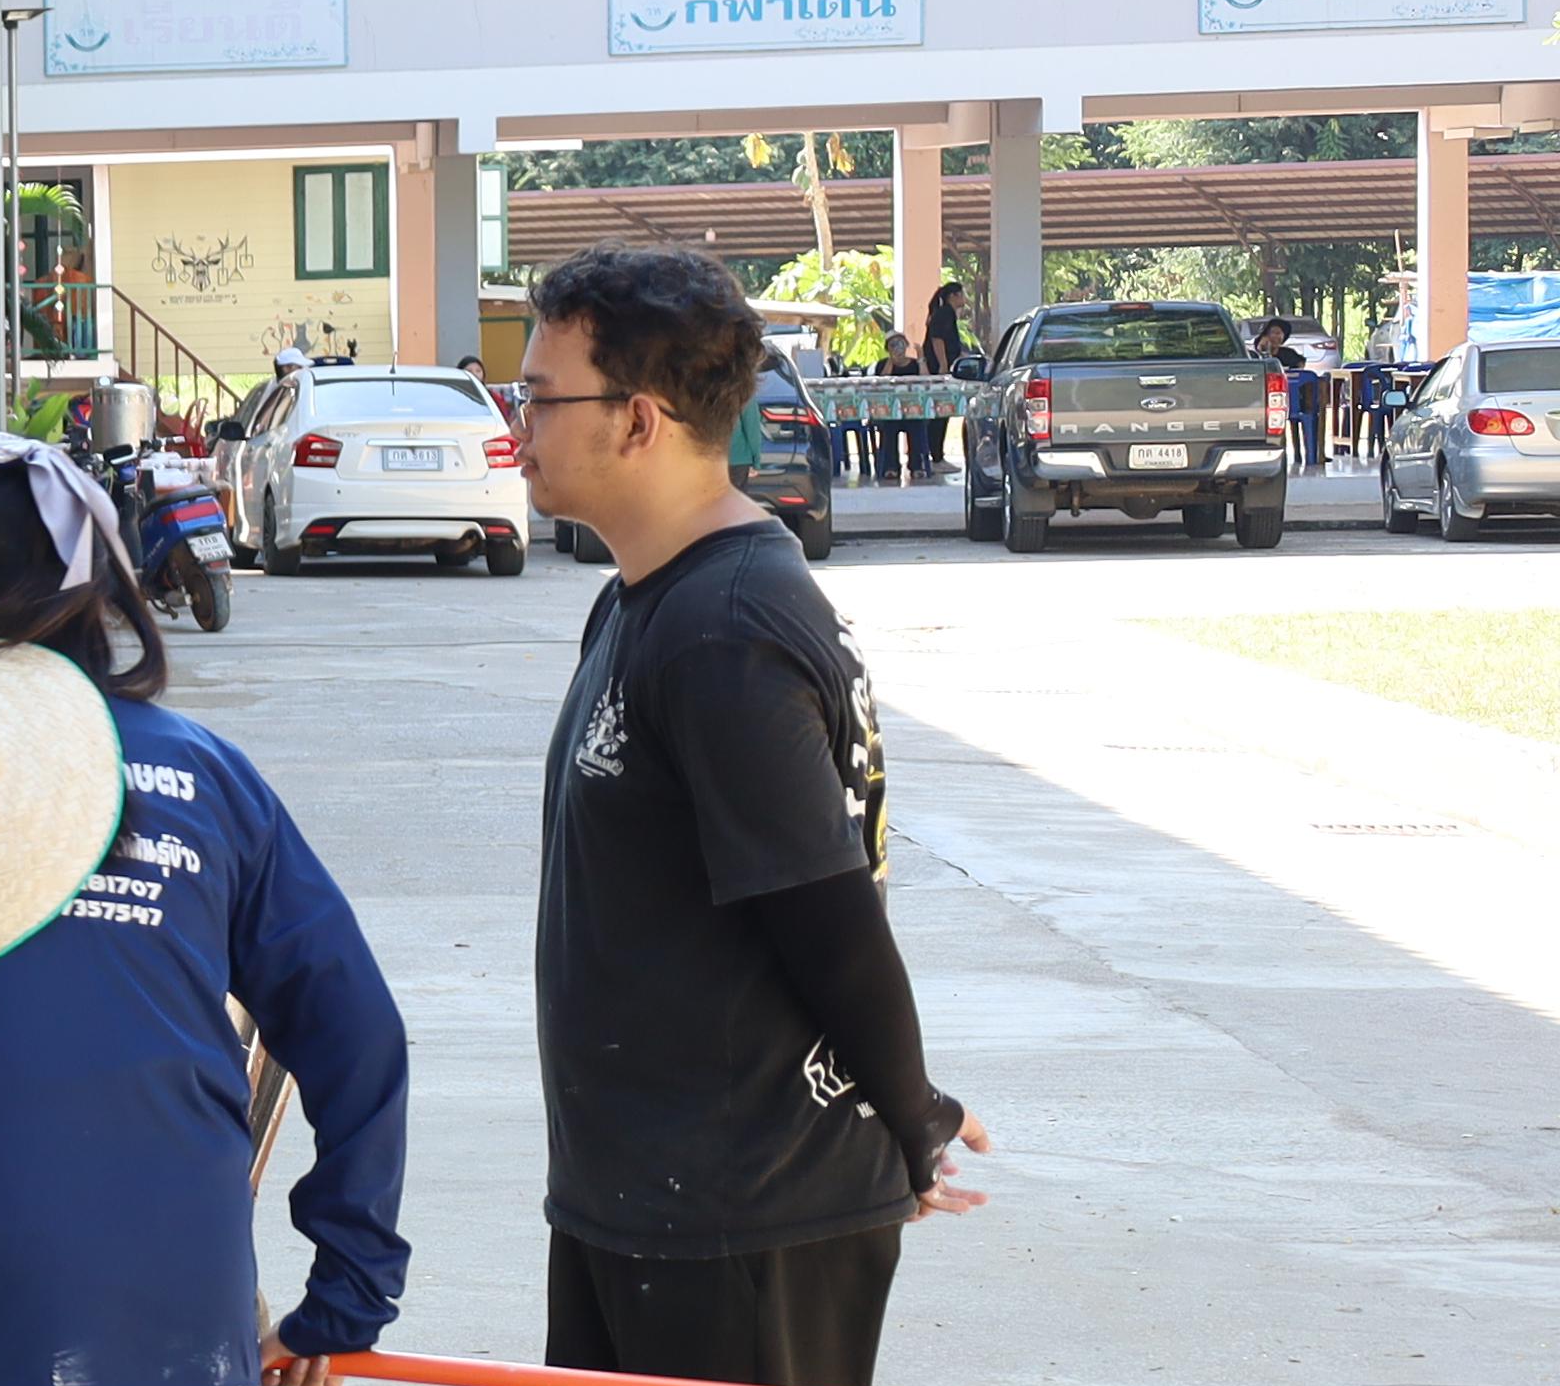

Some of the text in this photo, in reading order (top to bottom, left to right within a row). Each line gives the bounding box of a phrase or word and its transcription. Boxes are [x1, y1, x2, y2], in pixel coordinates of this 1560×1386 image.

[122, 0, 303, 46] เรียนดี
[1060, 420, 1257, 434] RANGER
[1158, 448, 1182, 459] 4418
